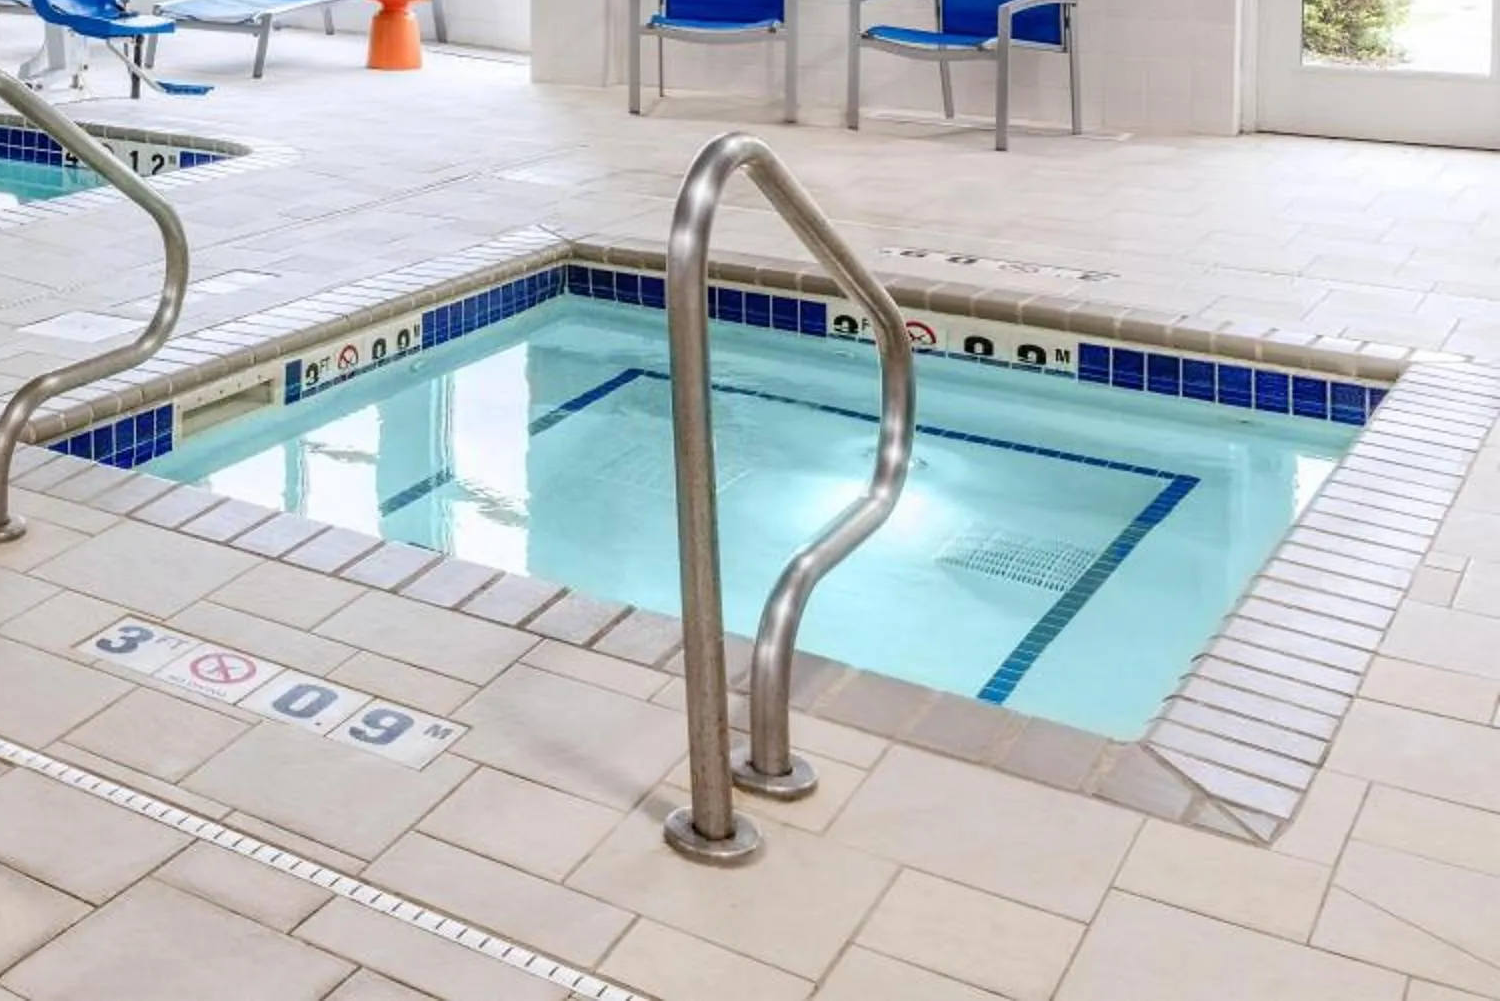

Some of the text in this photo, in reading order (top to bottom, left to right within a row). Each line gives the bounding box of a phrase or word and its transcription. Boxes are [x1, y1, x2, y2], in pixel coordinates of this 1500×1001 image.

[1055, 348, 1070, 363] M
[96, 625, 154, 654] 3
[423, 724, 453, 741] M
